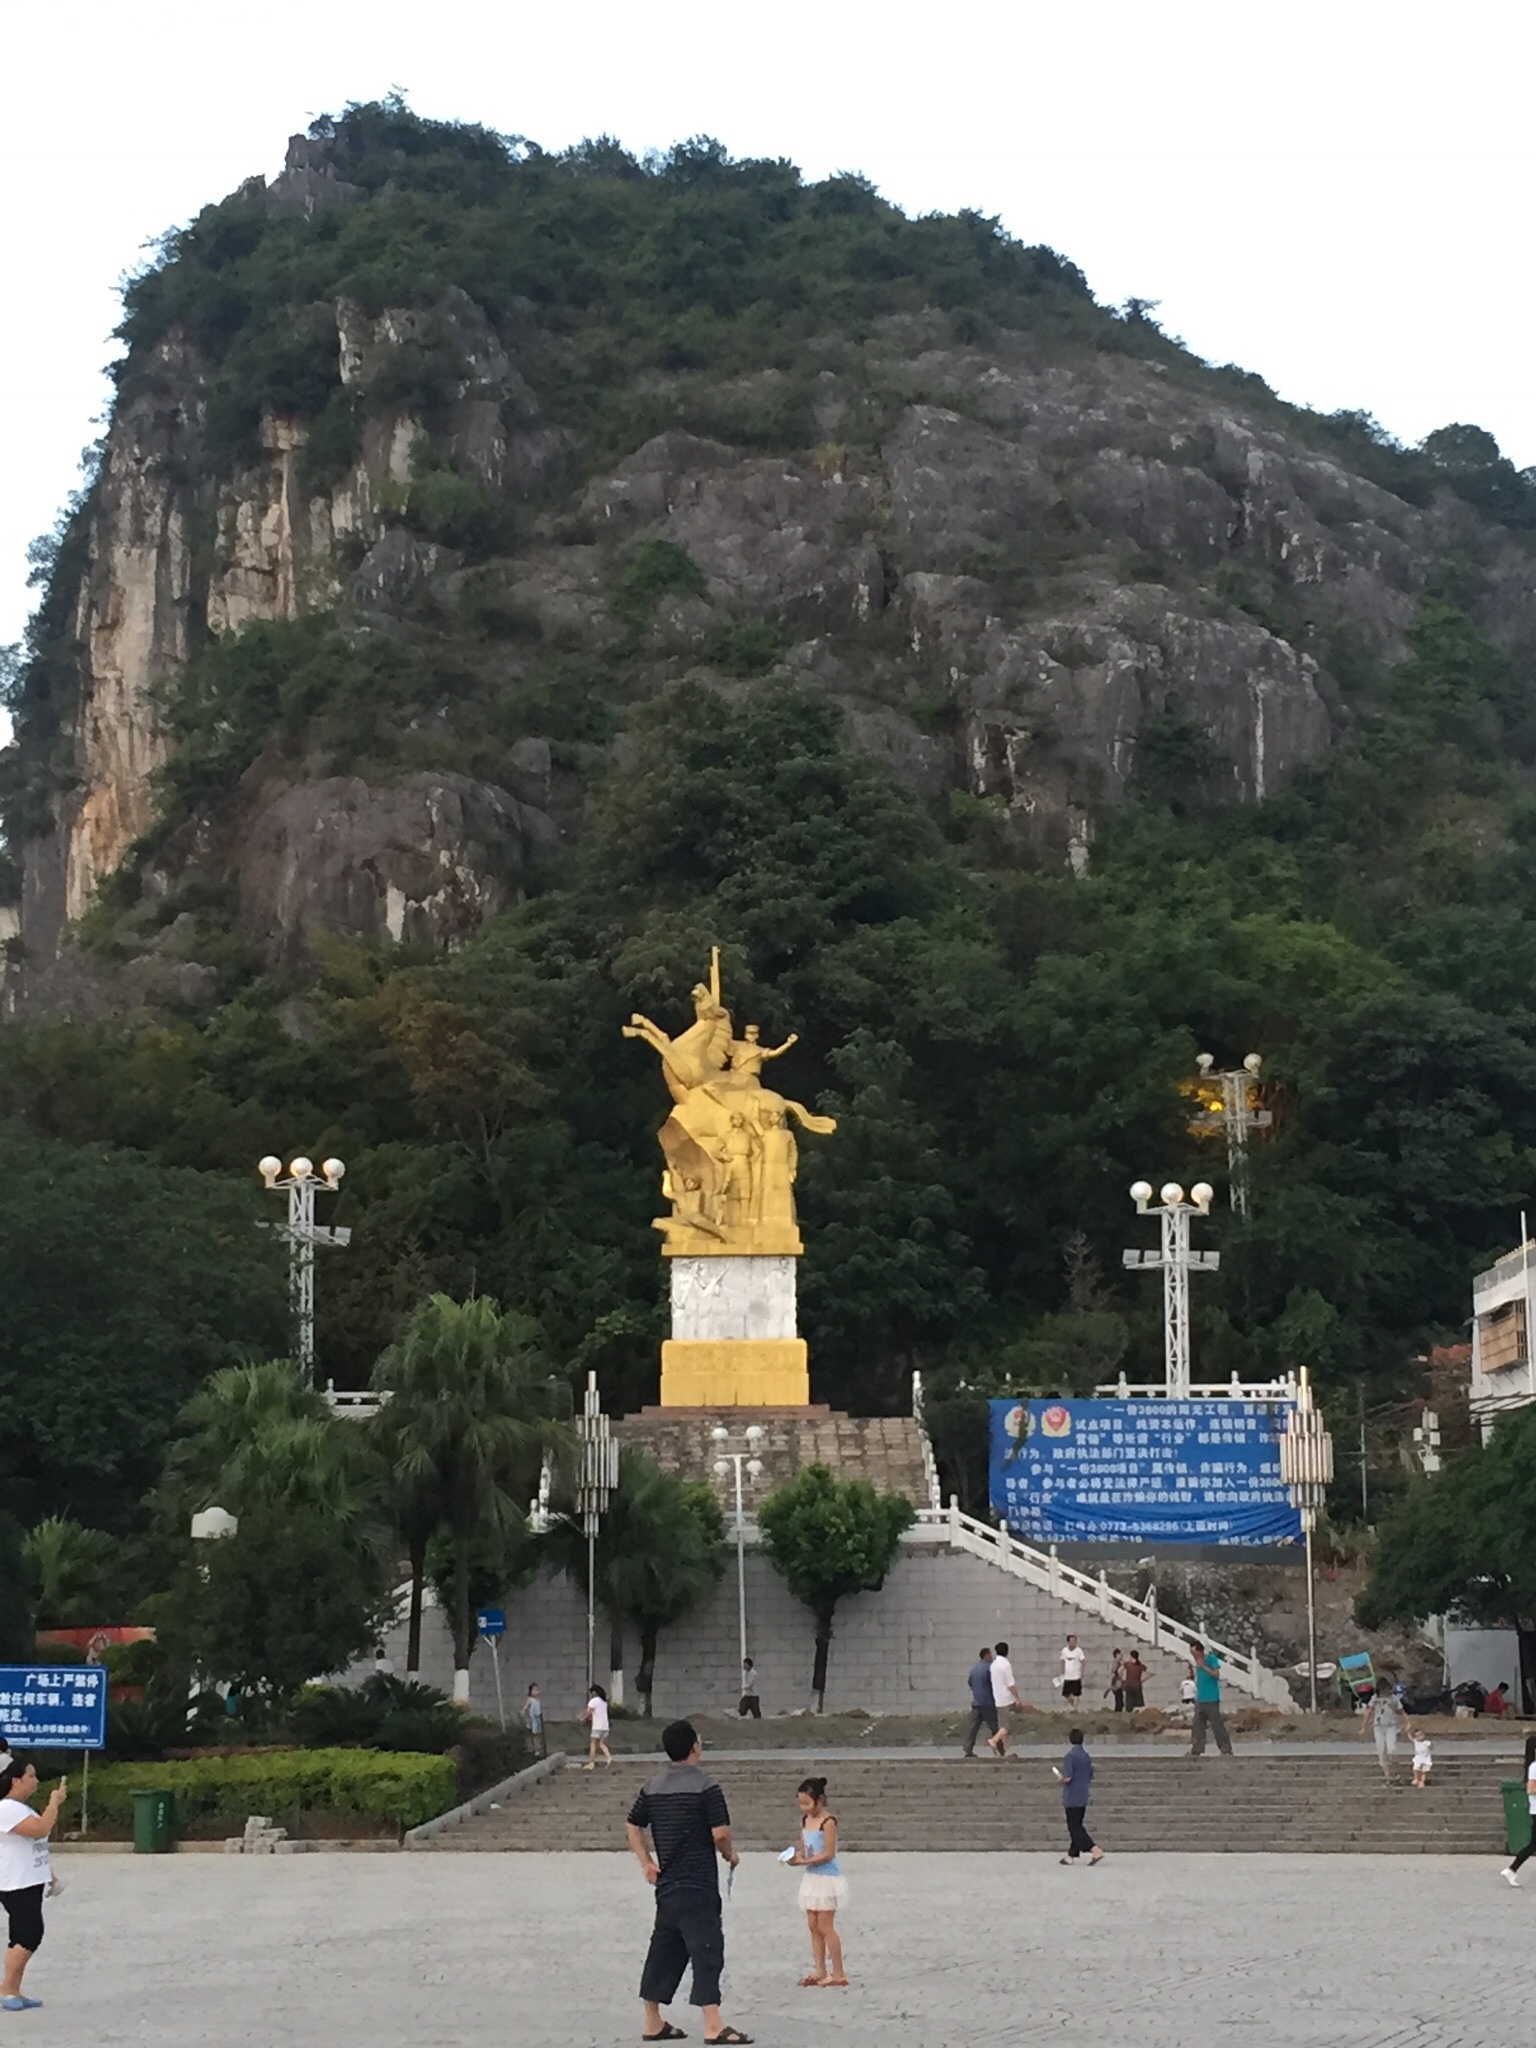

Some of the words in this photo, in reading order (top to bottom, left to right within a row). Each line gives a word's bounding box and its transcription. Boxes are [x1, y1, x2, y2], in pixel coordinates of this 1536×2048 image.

[24, 1672, 99, 1688] 广场上严禁停
